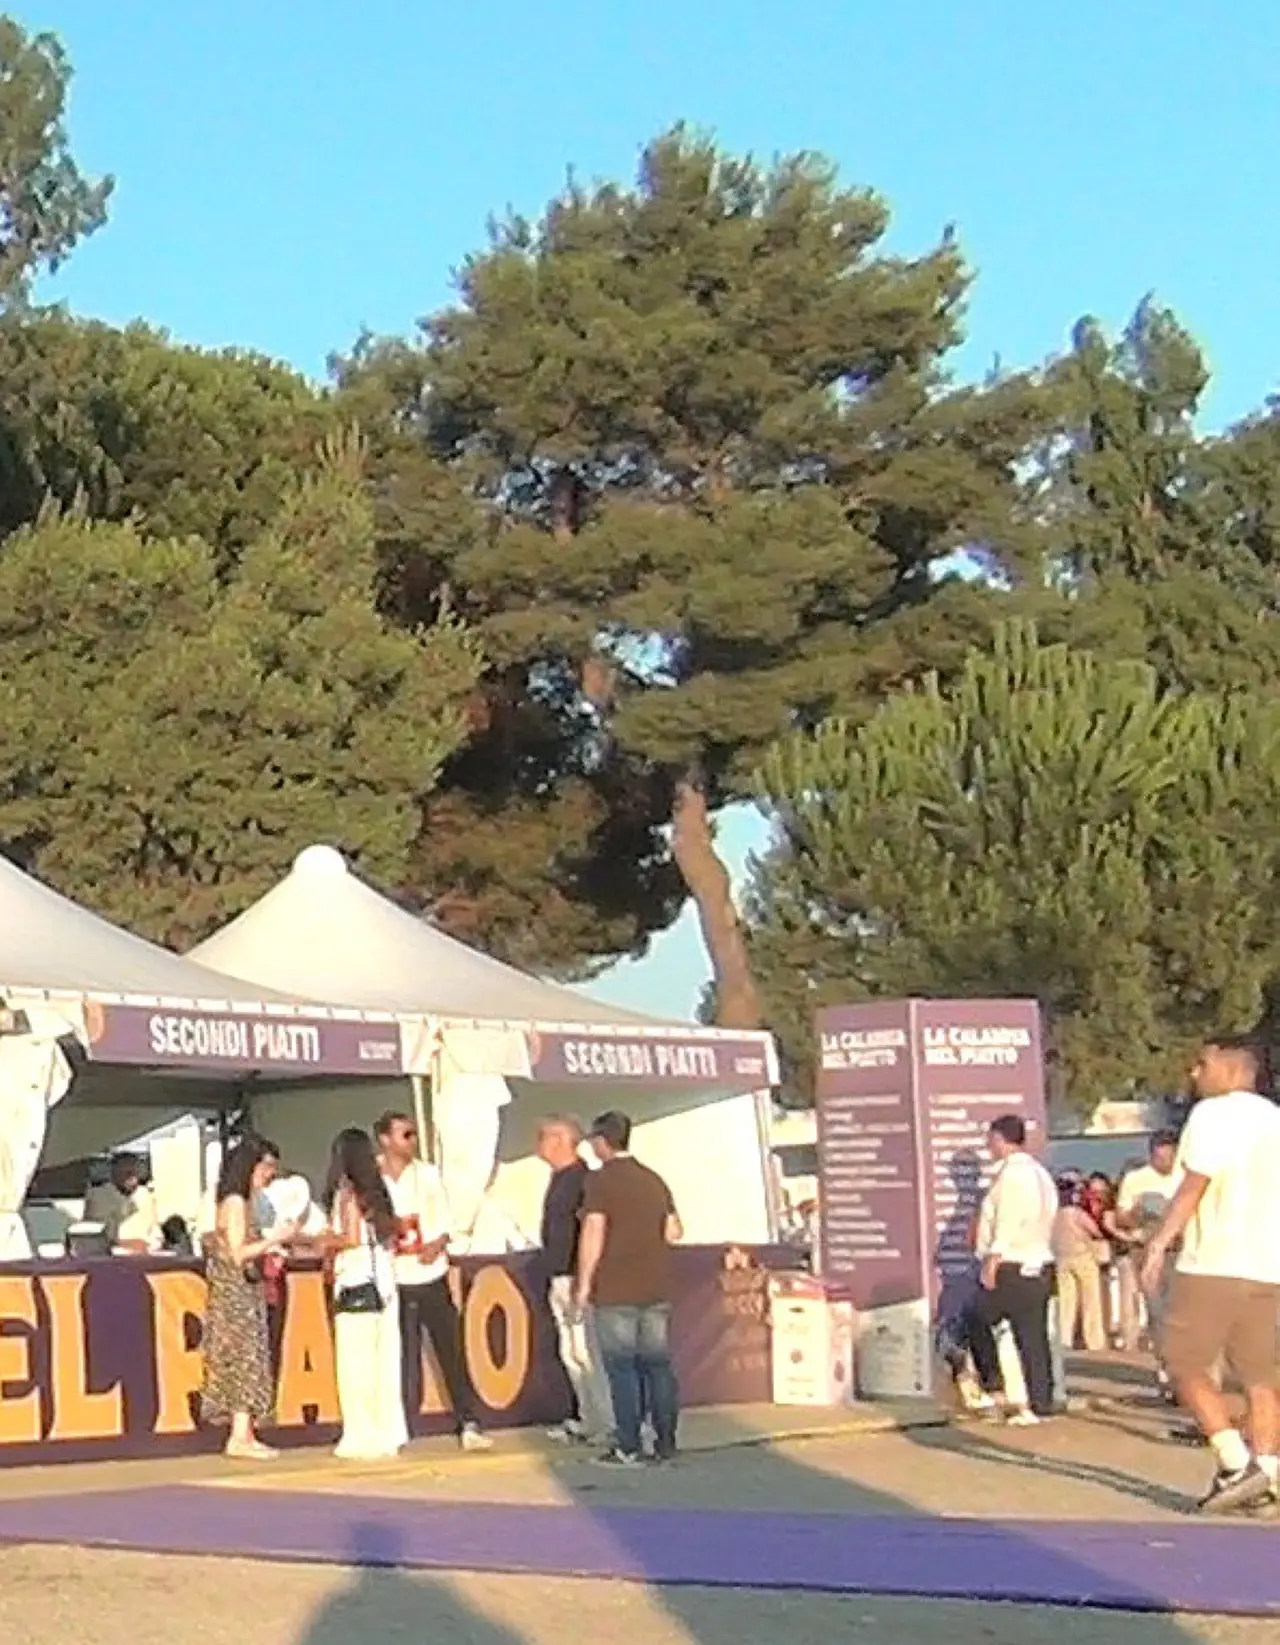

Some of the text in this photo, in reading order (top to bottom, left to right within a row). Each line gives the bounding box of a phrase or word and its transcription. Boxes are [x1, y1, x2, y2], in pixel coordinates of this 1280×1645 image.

[149, 1014, 249, 1057] SECONDI
[253, 1022, 321, 1062] PIATTI
[563, 1040, 653, 1075] SECONDI
[655, 1043, 719, 1077] PIATTI
